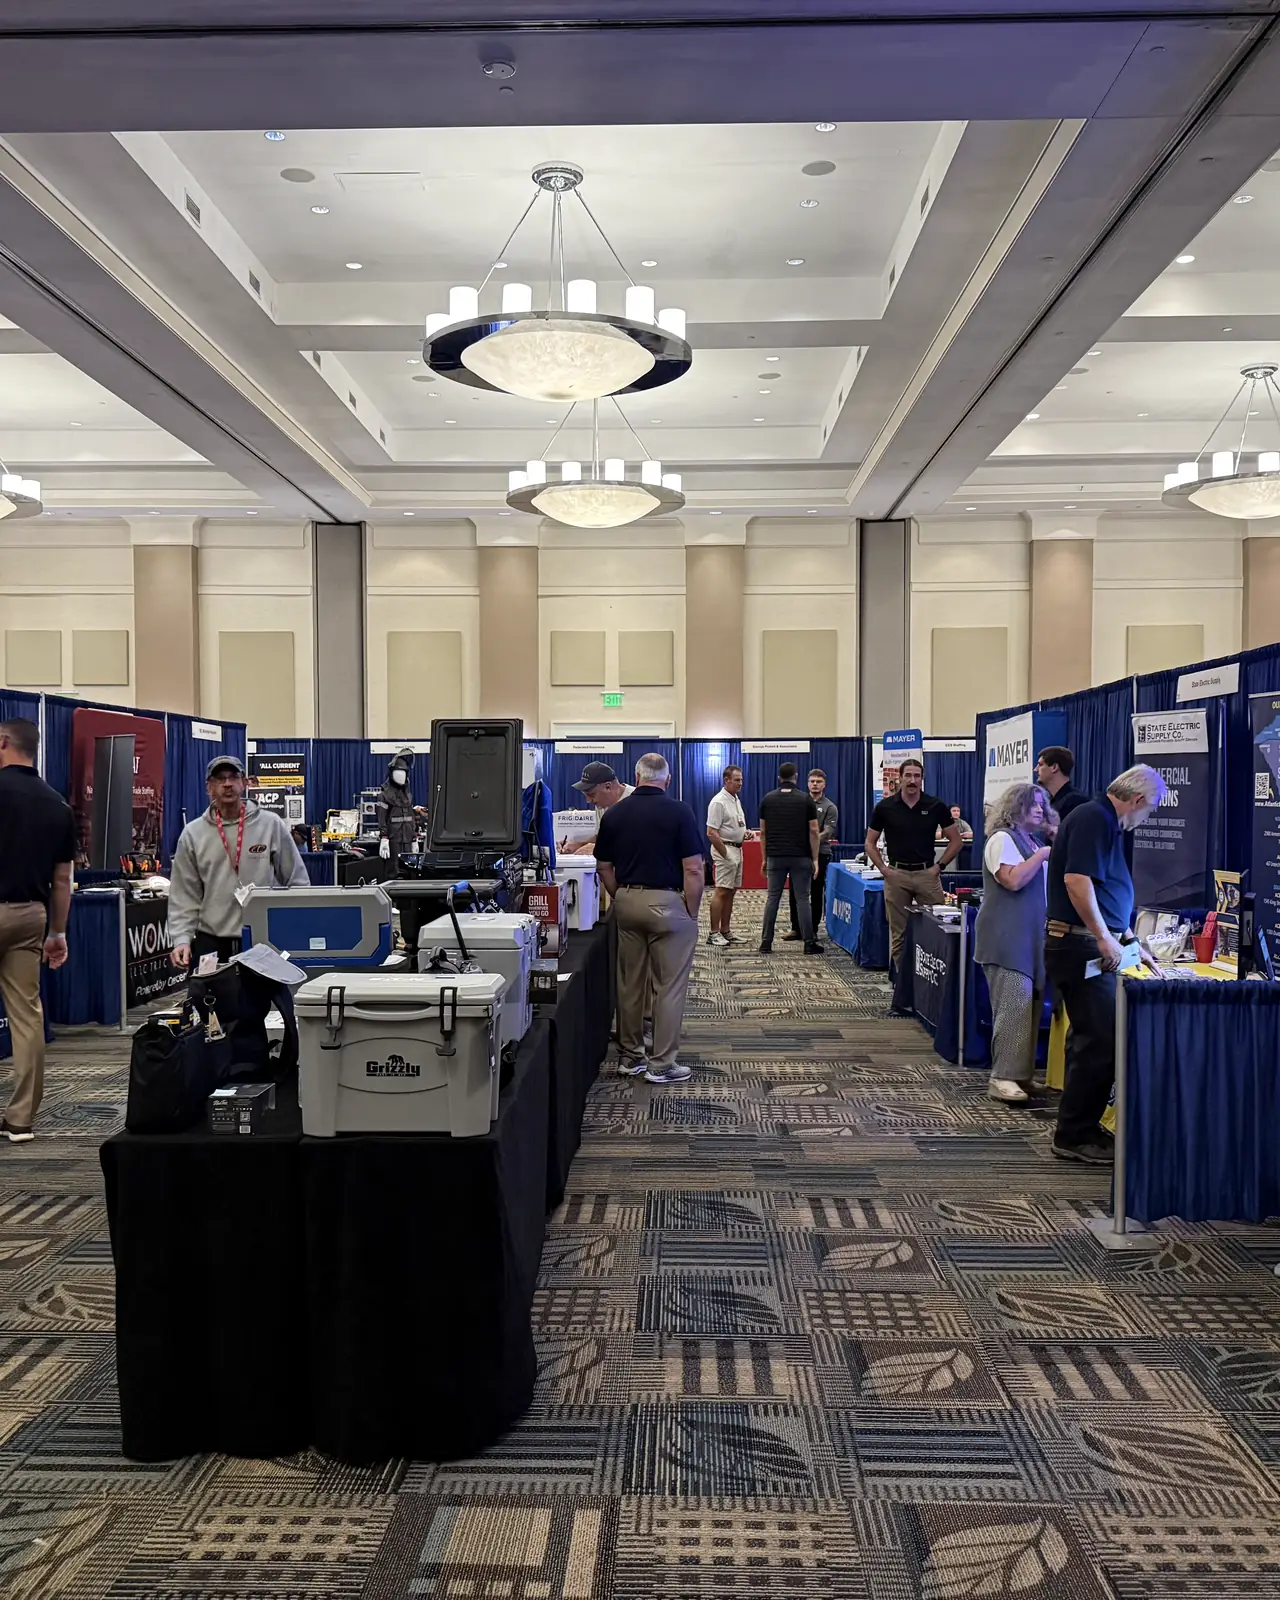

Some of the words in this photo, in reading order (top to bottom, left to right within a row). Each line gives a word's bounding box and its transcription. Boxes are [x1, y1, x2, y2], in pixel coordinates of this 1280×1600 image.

[605, 695, 622, 706] EXIT
[1168, 722, 1201, 731] ELECTRIC
[892, 735, 916, 743] MAYER
[1147, 732, 1171, 740] SUPPLY
[997, 739, 1029, 767] MAYER
[528, 895, 549, 906] GRILL
[838, 900, 851, 924] MAYER
[366, 1061, 421, 1077] Grizzly
